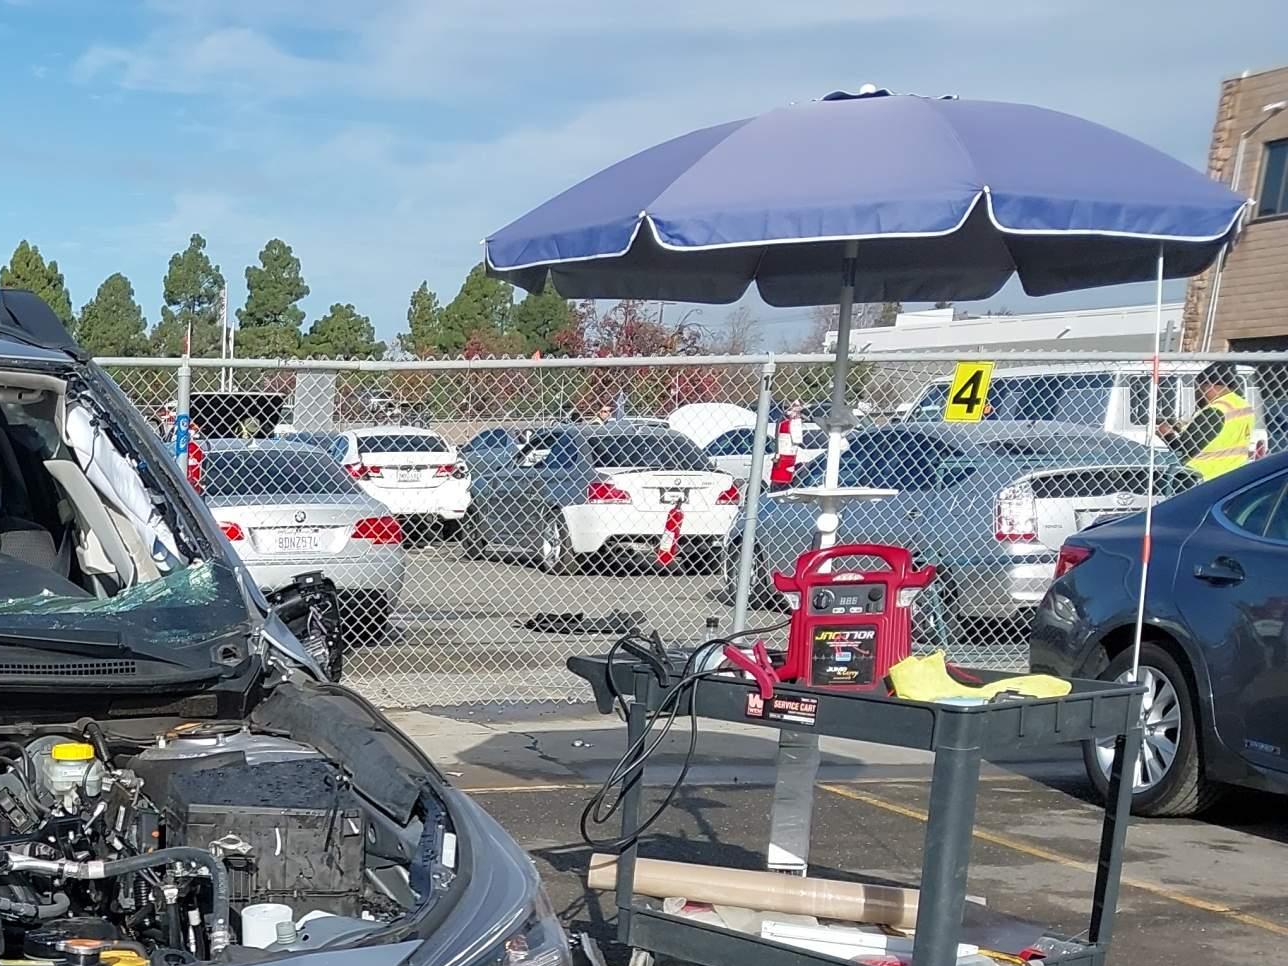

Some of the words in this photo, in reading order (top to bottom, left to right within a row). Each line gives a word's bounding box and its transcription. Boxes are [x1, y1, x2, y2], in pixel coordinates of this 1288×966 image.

[952, 369, 984, 414] 4
[773, 699, 800, 711] SERVICE
[800, 703, 816, 713] CART
